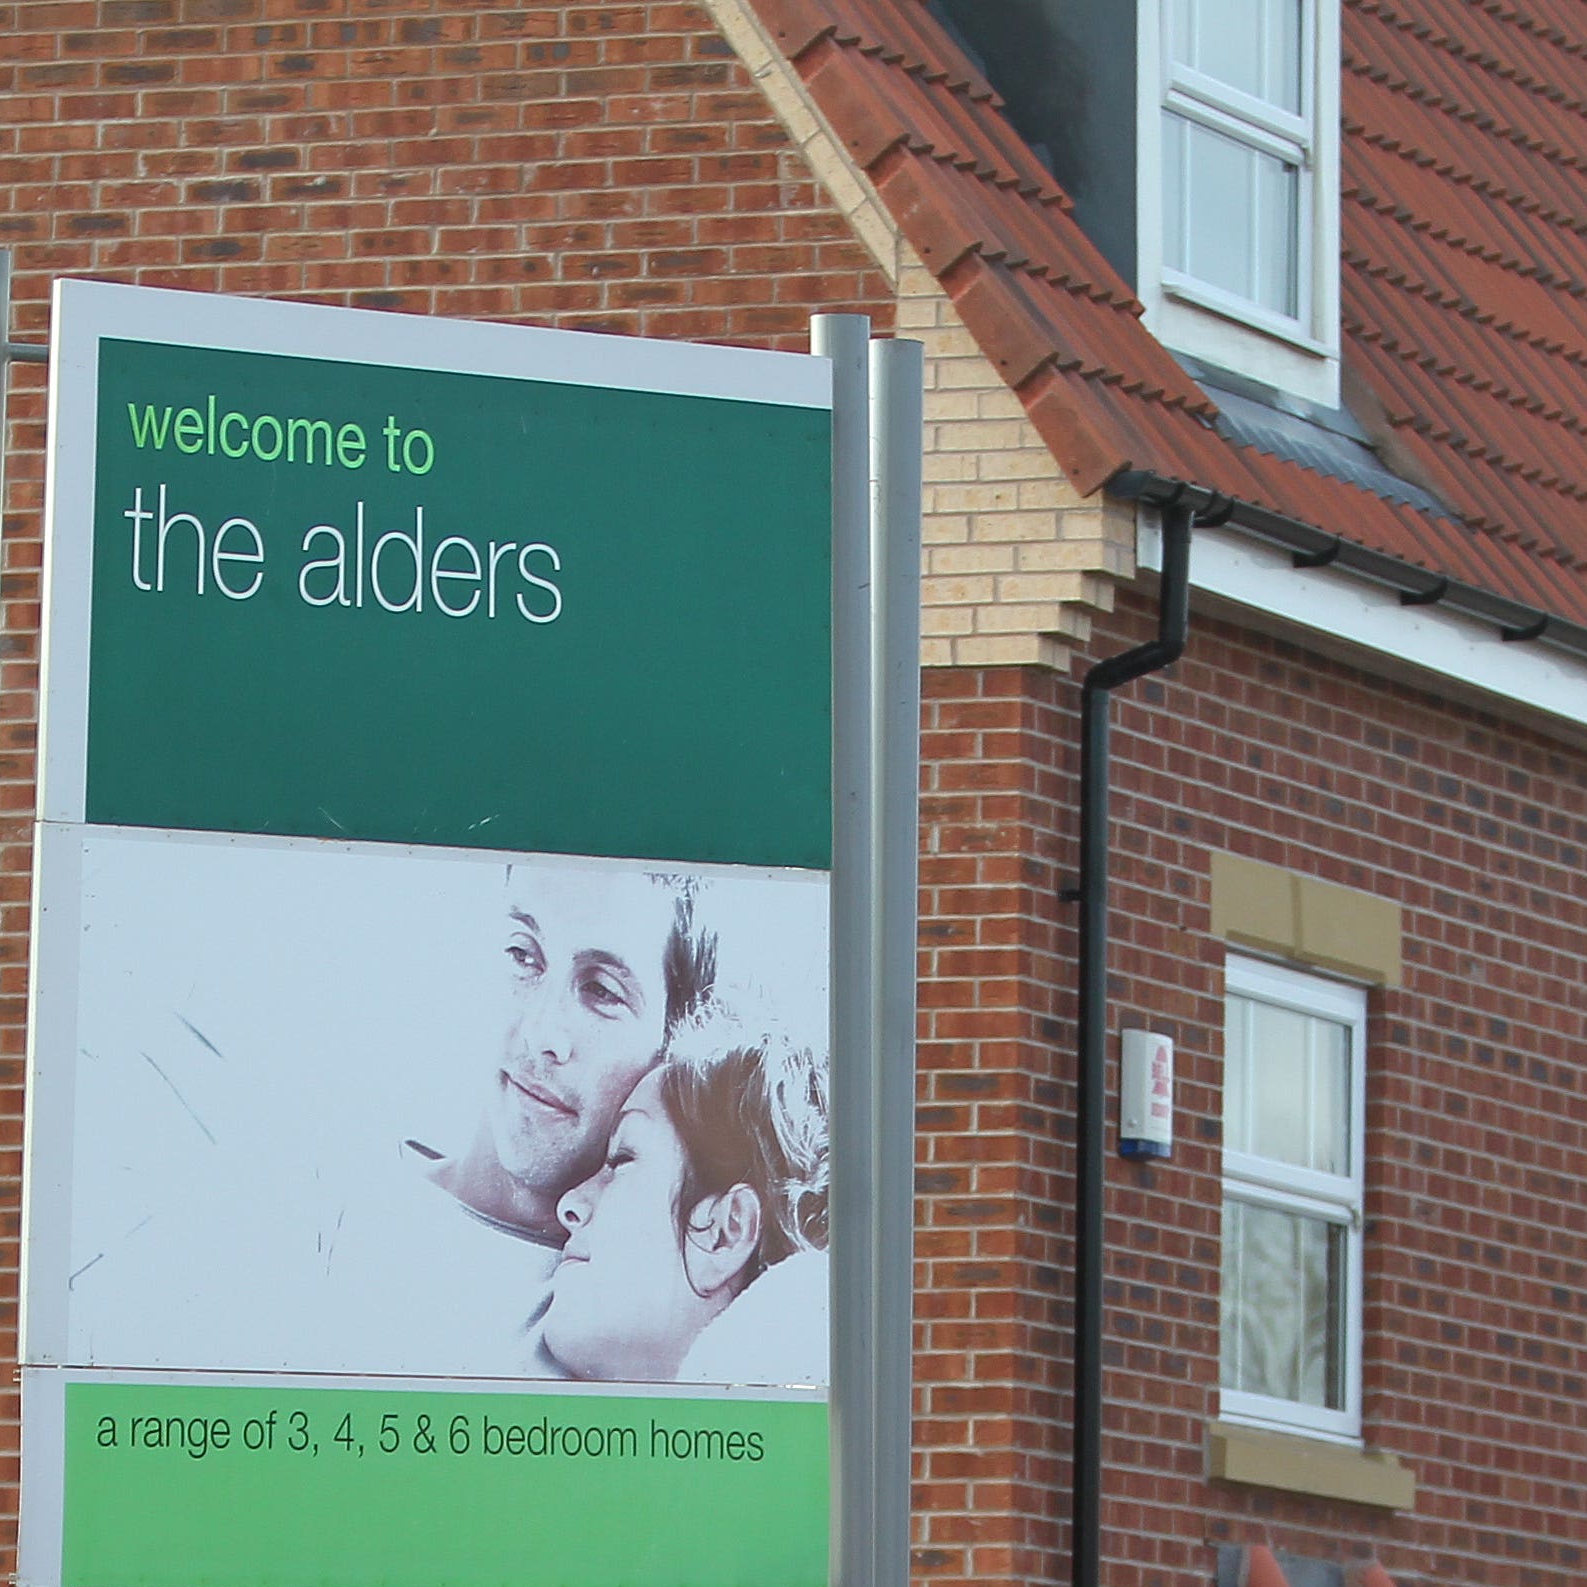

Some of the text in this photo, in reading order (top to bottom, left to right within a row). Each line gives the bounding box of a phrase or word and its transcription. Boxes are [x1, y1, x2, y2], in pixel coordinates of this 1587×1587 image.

[127, 394, 436, 475] welcome to
[124, 483, 563, 624] the alders
[96, 1410, 766, 1463] a range of 3, 4, 5 & 6 bedroom homes
